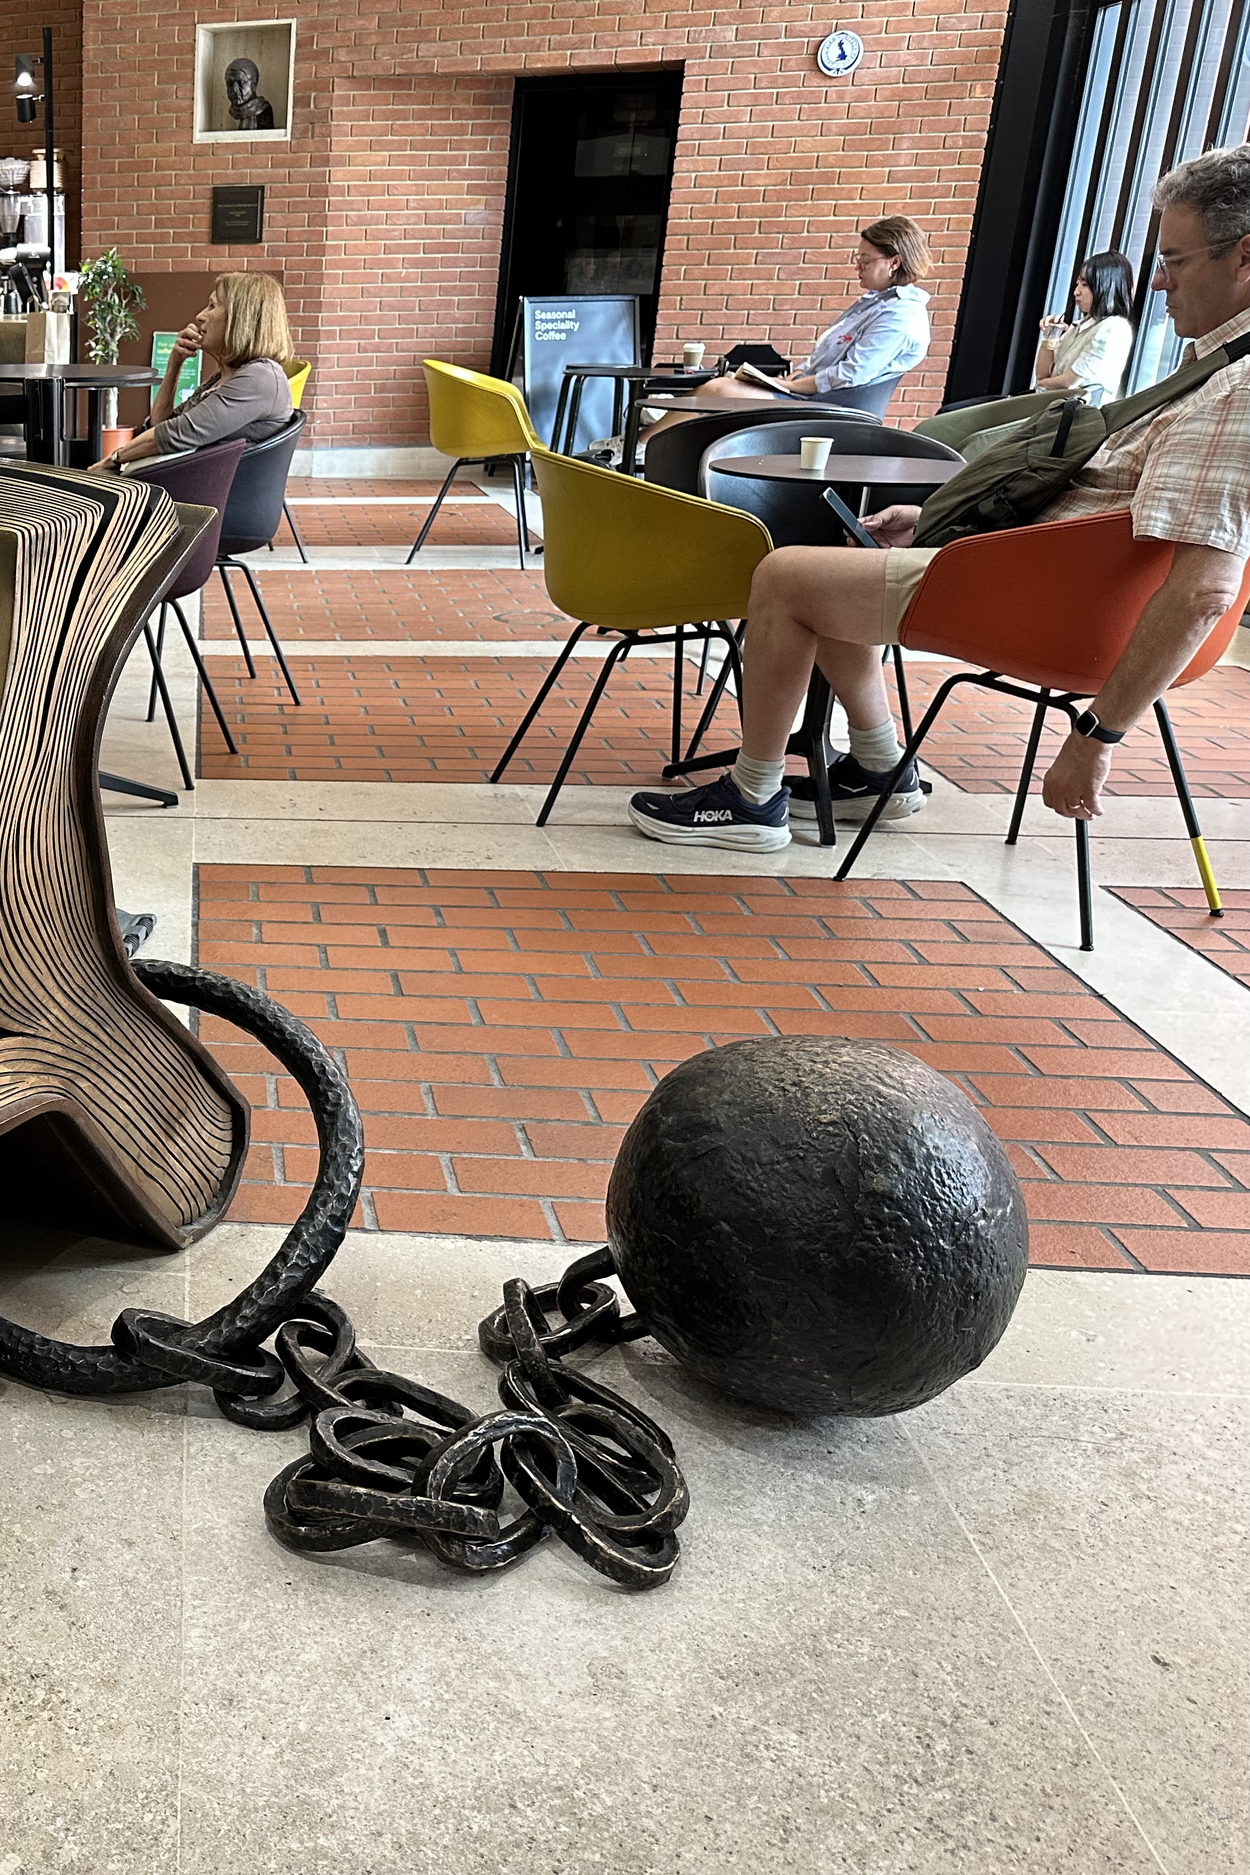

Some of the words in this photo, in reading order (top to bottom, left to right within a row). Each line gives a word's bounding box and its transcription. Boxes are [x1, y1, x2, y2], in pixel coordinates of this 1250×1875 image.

[535, 309, 576, 320] Seasonal
[535, 320, 580, 332] Speciality
[535, 331, 567, 341] Coffee
[693, 810, 733, 822] HOKA
